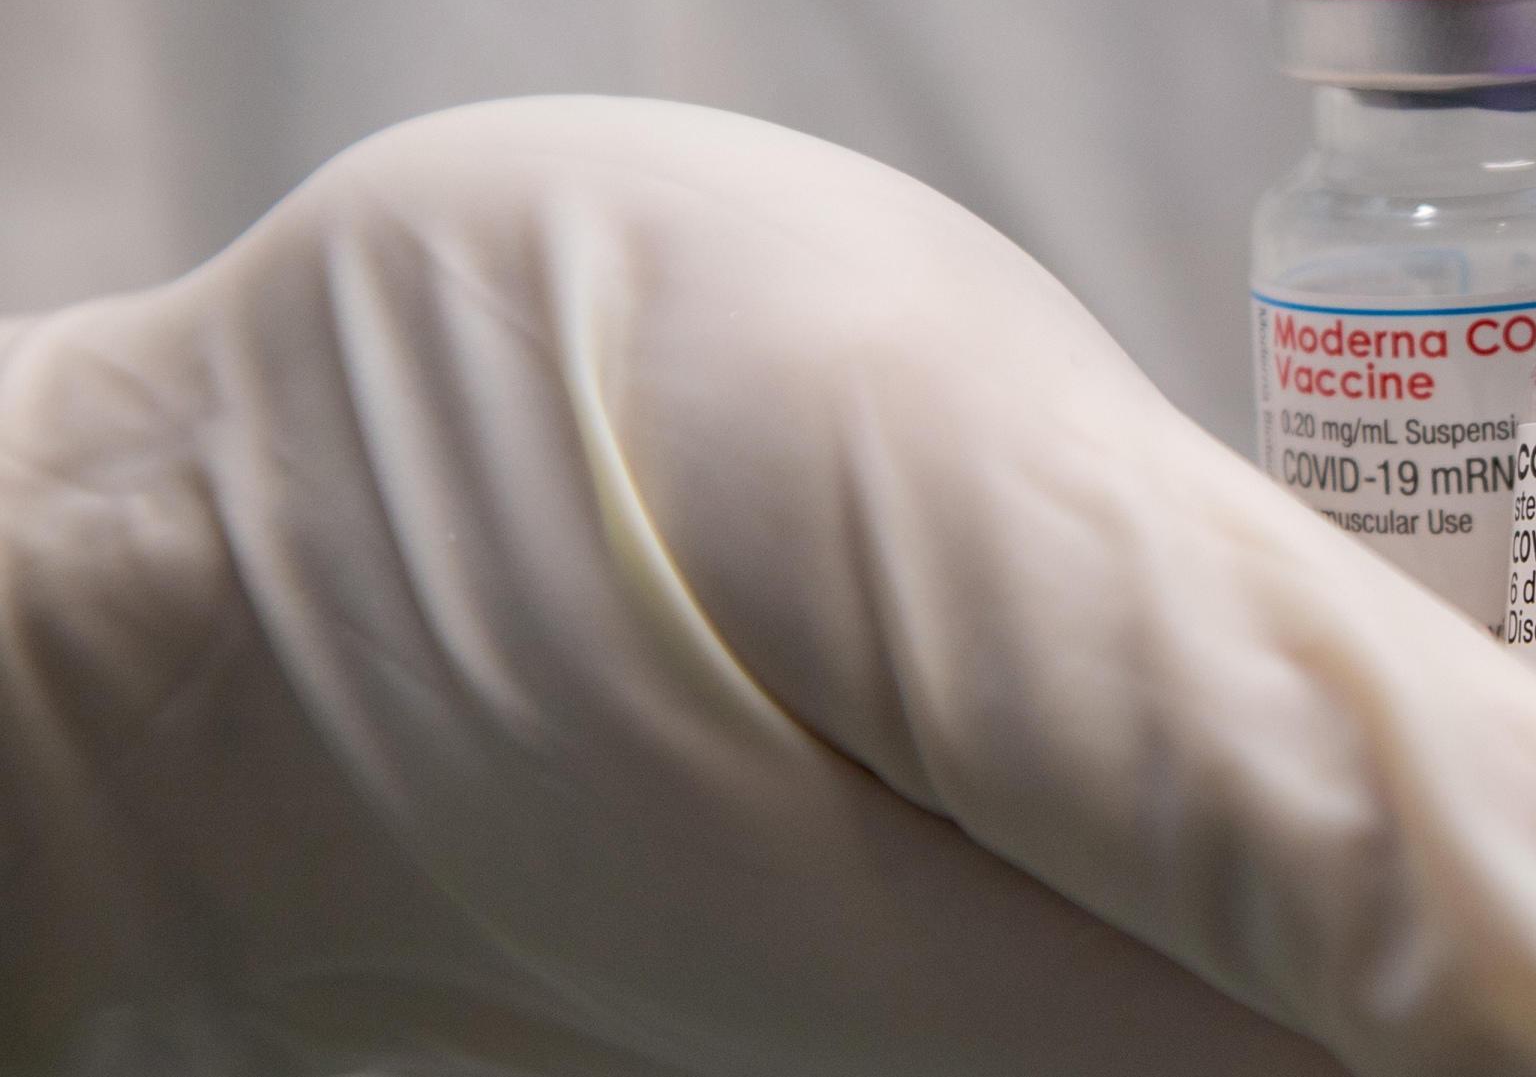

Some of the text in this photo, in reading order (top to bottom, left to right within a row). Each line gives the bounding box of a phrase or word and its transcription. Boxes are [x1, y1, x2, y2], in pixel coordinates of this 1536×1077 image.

[1274, 310, 1448, 359] Moderna
[1276, 354, 1435, 400] Vaccine
[1281, 410, 1517, 448] 0.20 mg/mL Suspensi
[1283, 449, 1419, 495] COVID-19
[1428, 508, 1473, 535] Use
[1510, 572, 1518, 605] 6
